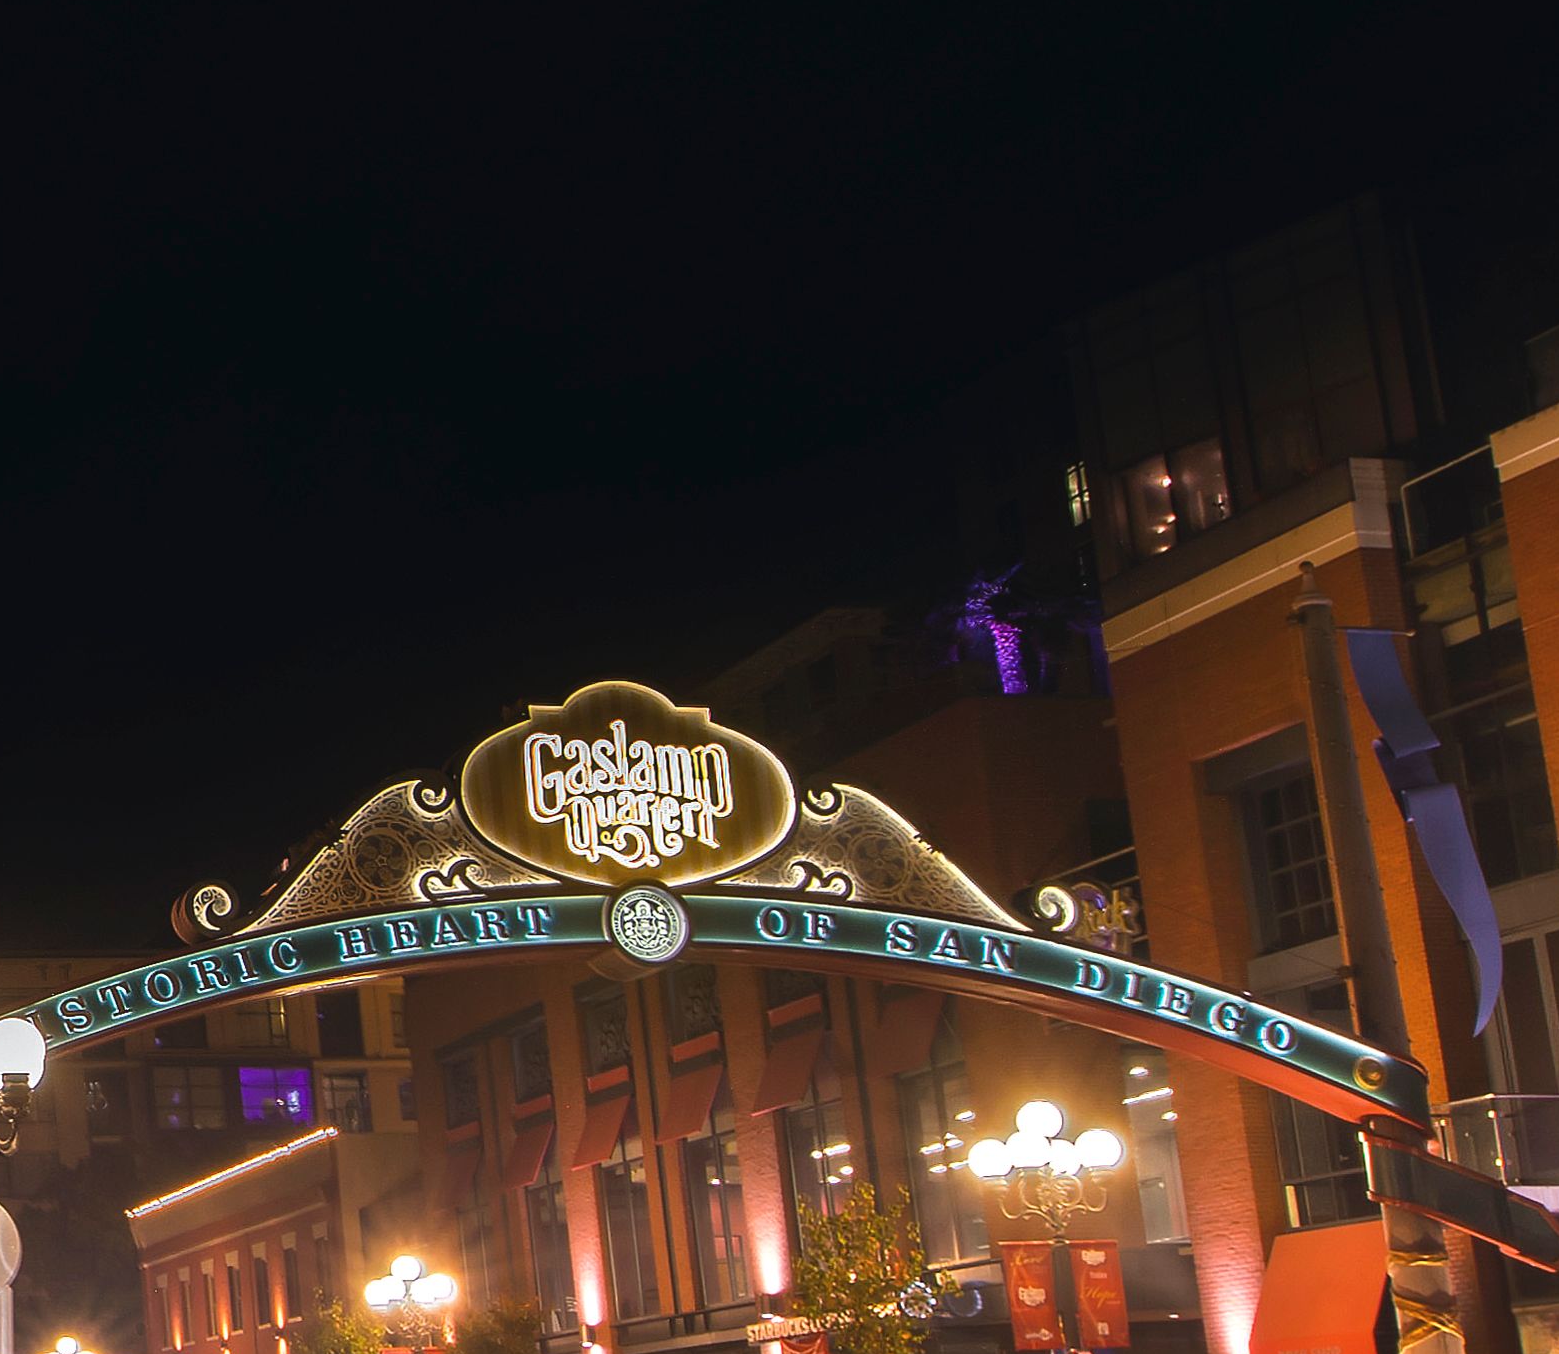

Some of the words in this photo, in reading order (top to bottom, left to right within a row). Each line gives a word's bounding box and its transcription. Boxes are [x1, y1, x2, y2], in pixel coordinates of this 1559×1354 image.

[524, 719, 733, 823] Gaslamp
[562, 790, 721, 869] Quarter
[337, 904, 552, 961] HEART
[756, 905, 836, 942] OF
[885, 920, 1021, 973] SAN
[1071, 958, 1298, 1055] DIEGO
[747, 1315, 811, 1343] STARBUCKS
